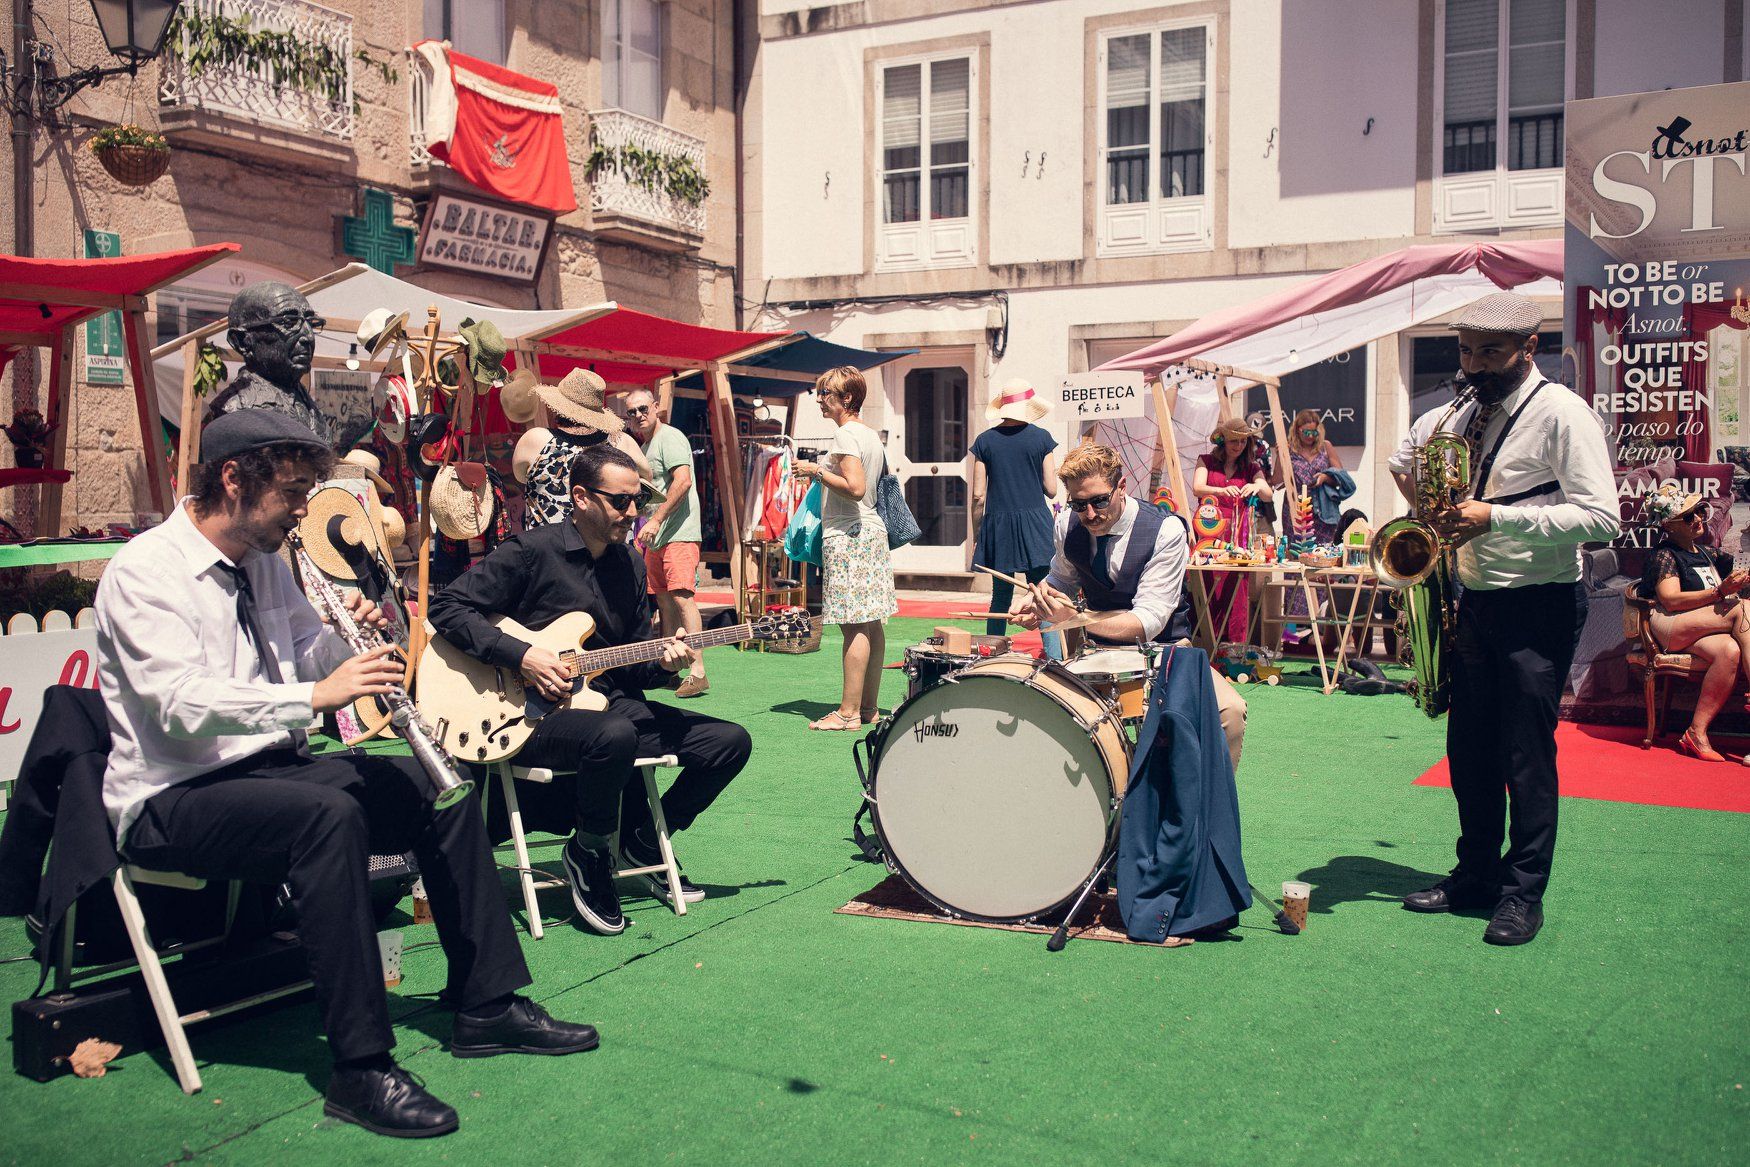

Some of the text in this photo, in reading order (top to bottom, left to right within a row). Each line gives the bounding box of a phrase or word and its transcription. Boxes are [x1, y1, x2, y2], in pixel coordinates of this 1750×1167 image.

[441, 203, 537, 249] BALTAR
[433, 239, 528, 274] FARMACIA
[1604, 260, 1709, 285] TO BE or
[1588, 281, 1724, 310] NOT TO BE
[1617, 312, 1688, 335] Asnot.
[1600, 340, 1710, 366] OUTFITS
[1624, 366, 1683, 394] QUE
[1062, 385, 1135, 402] BEBETECA
[1592, 390, 1715, 414] RESISTEN
[1616, 420, 1670, 444] paso
[1676, 413, 1704, 436] do
[1617, 444, 1686, 467] tempo
